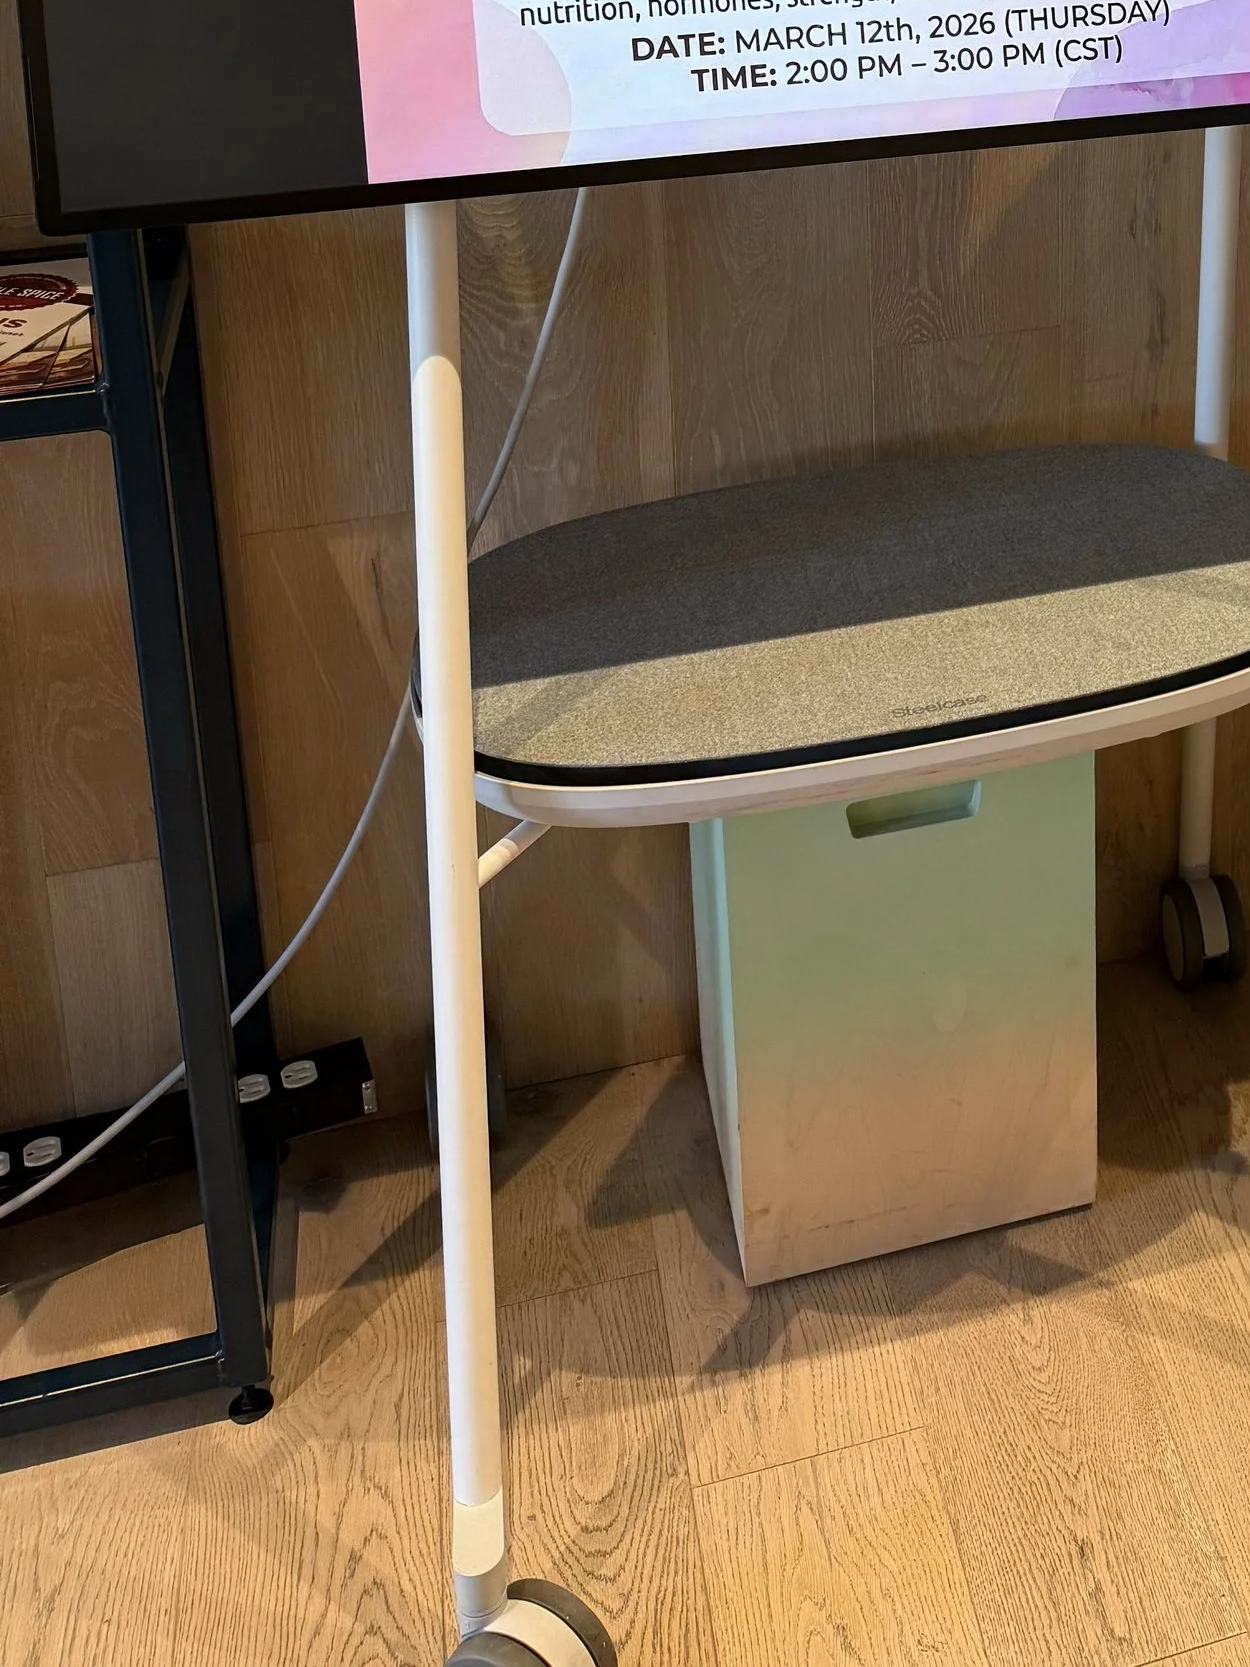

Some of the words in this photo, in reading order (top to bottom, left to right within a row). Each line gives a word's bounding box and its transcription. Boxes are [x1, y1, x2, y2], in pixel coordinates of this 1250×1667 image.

[631, 31, 726, 62] DATE:
[735, 22, 847, 54] MARCH
[855, 16, 921, 45] 12th,
[927, 11, 996, 39] 2026
[690, 63, 777, 92] TIME:
[785, 57, 848, 85] 2:00
[857, 53, 902, 80] PM
[933, 46, 993, 73] 3:00
[1002, 42, 1045, 68] PM
[1055, 34, 1123, 68] (CST)
[17, 288, 65, 300] SPICE
[892, 695, 988, 718] Steelcase
